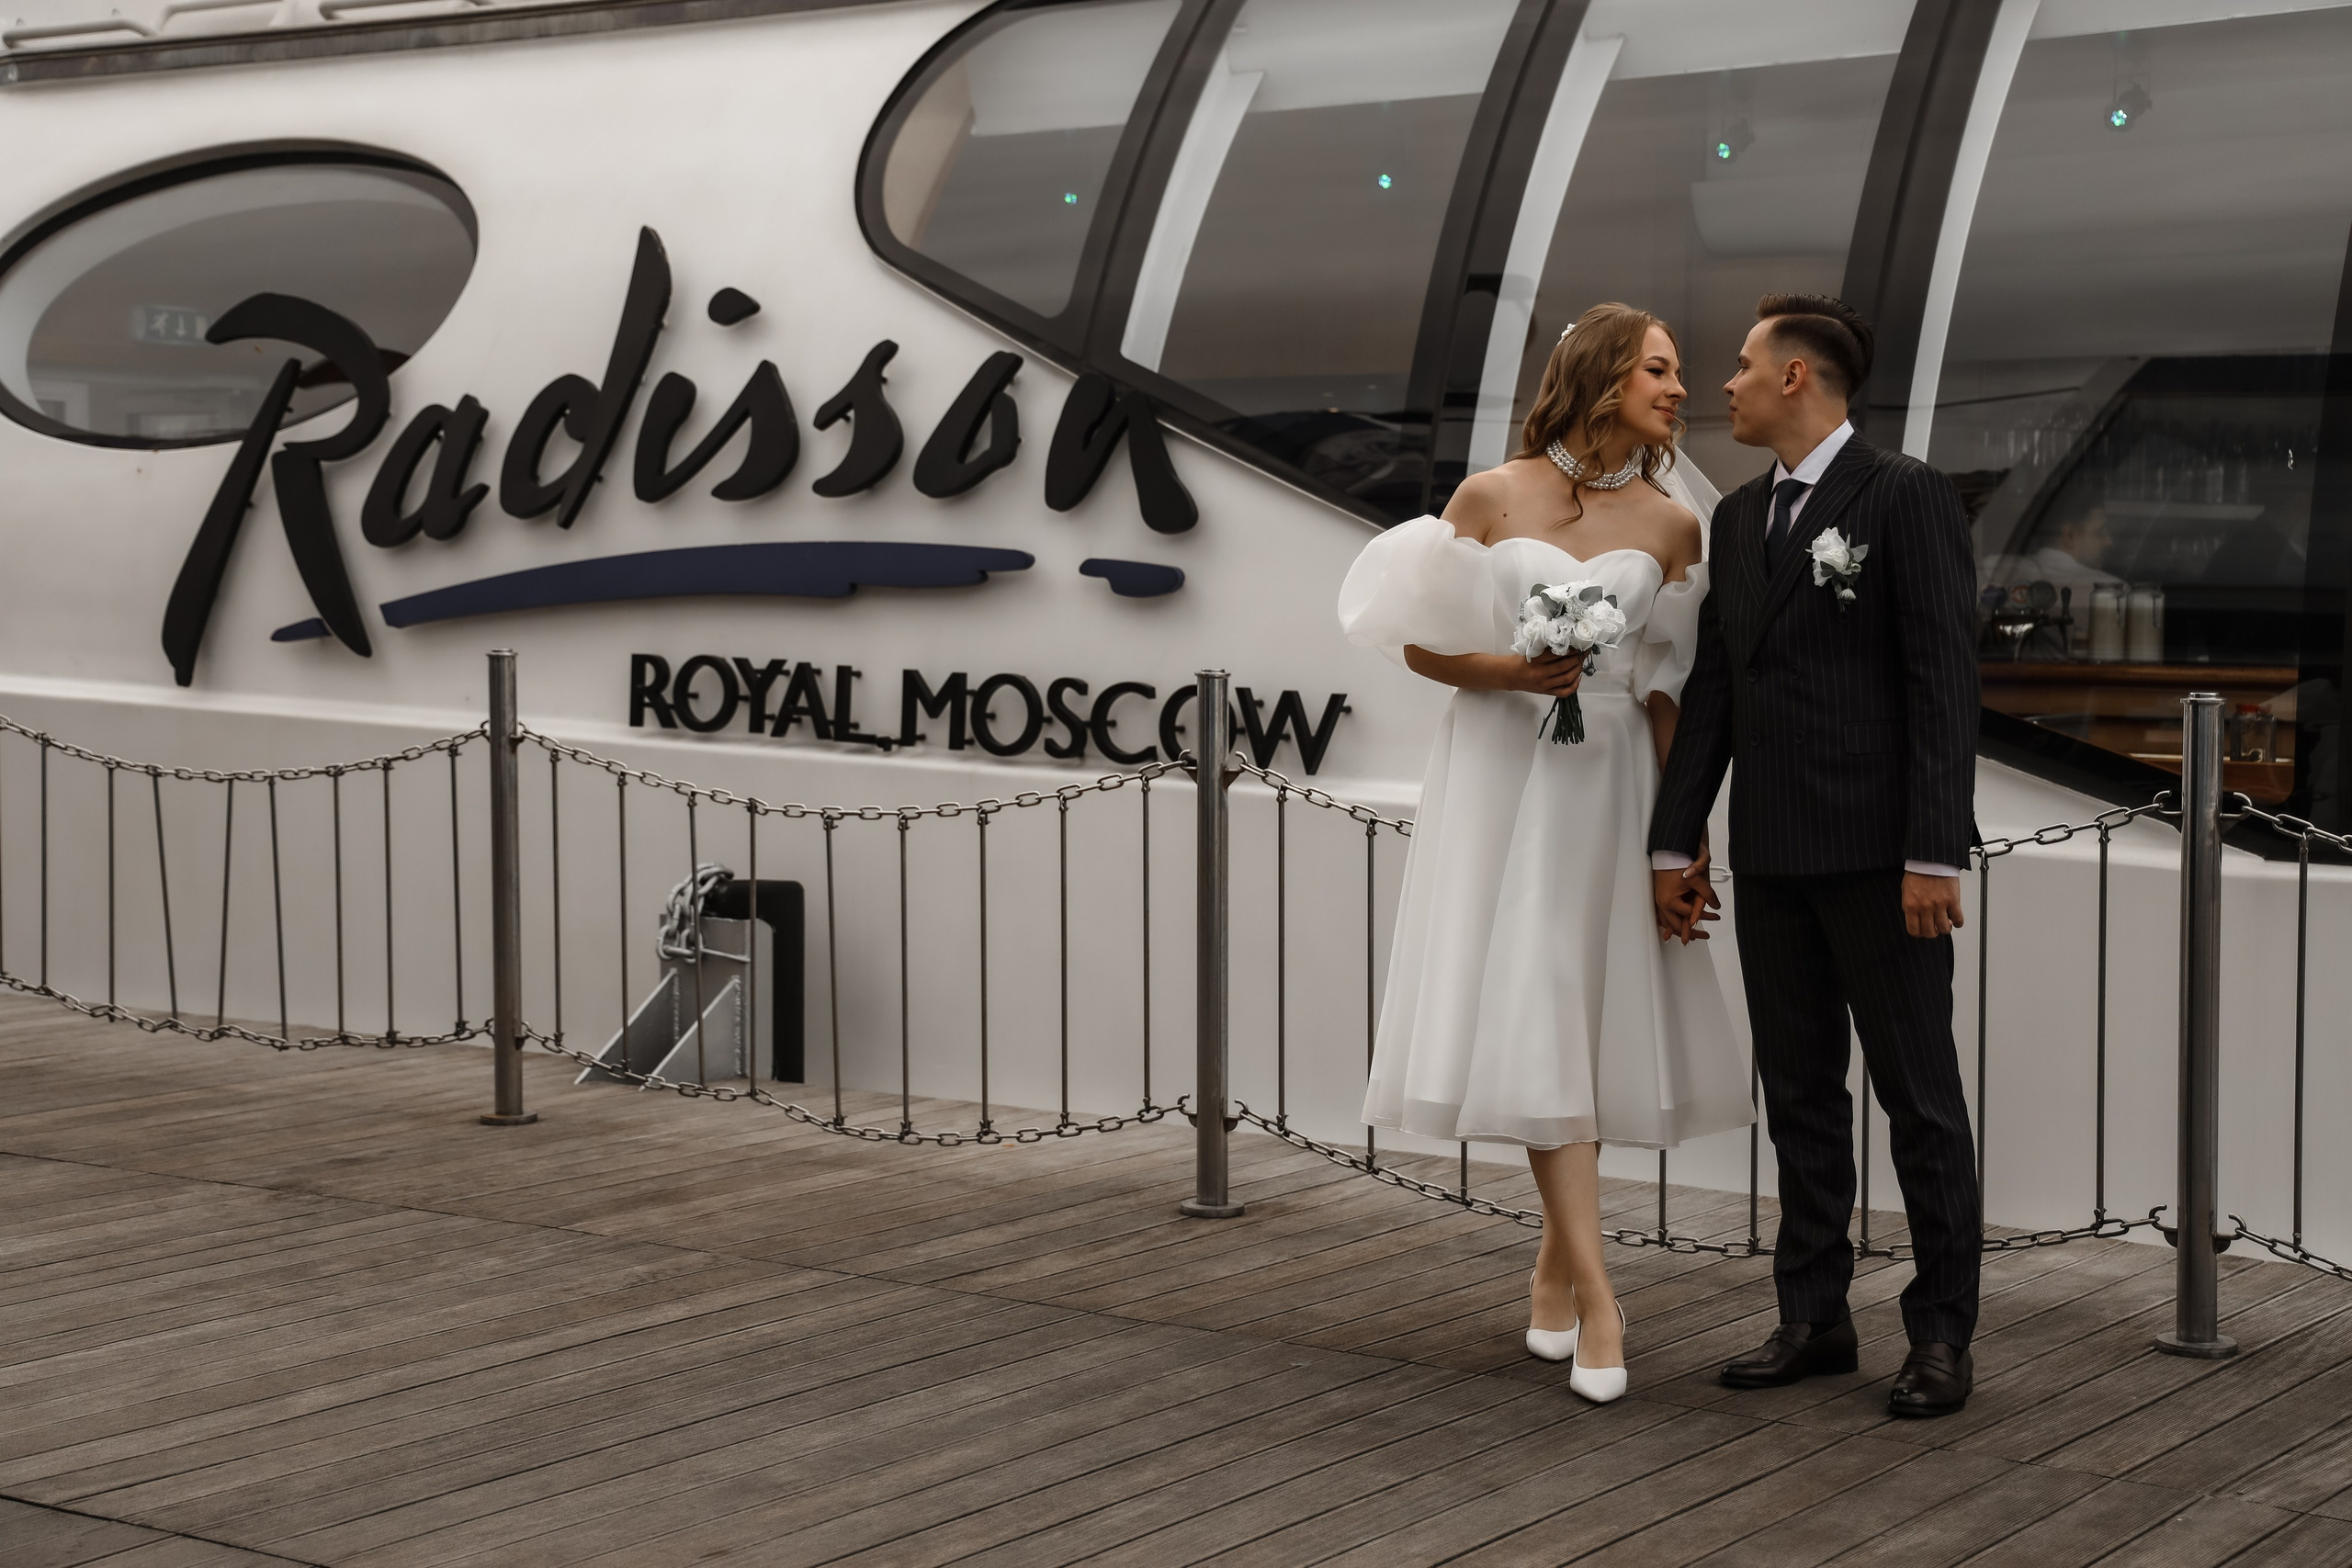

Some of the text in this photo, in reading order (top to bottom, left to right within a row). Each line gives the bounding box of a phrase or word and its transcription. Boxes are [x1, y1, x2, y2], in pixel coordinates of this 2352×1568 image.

[162, 225, 1198, 687] Radisson
[629, 653, 1348, 776] ROYAL MOSCOW
